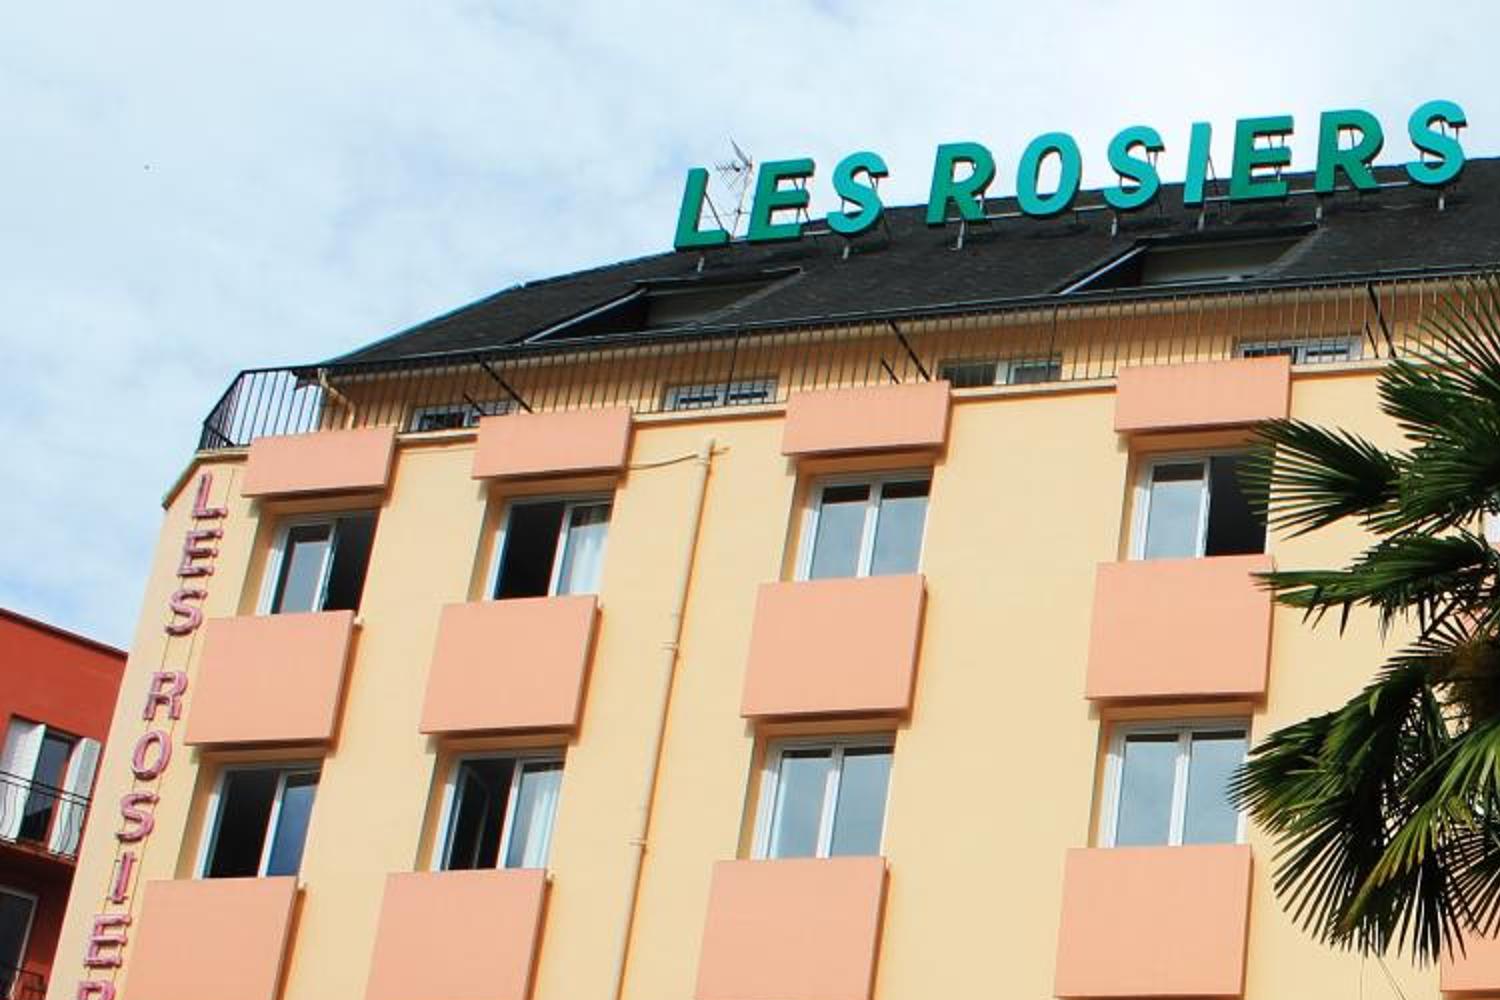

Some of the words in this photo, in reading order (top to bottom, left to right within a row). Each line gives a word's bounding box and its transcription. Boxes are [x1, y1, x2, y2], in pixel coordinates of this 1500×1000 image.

[675, 151, 888, 250] LES
[927, 99, 1467, 223] ROSIERS
[167, 474, 227, 635] LES
